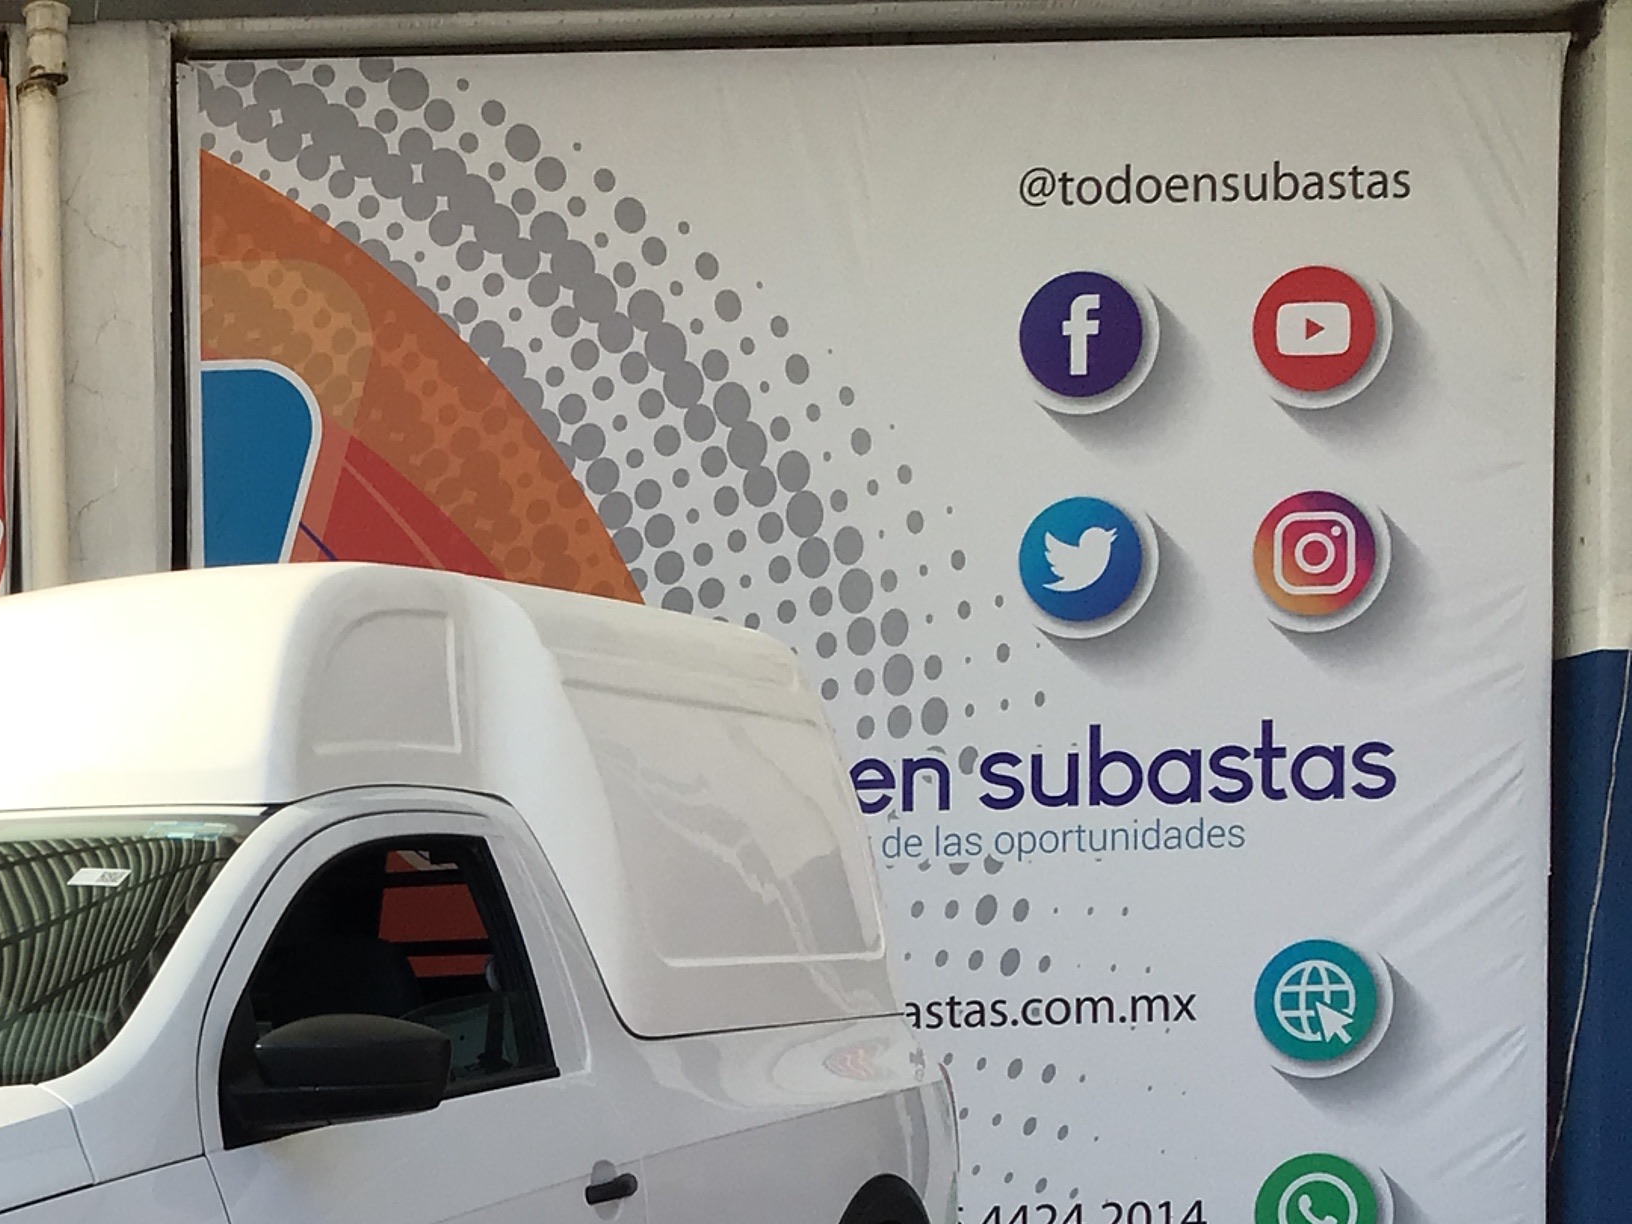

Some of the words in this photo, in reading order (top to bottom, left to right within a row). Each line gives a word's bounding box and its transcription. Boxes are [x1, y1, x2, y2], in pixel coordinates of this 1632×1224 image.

[1018, 160, 1412, 207] @todoensubastas
[849, 757, 951, 815] en
[978, 718, 1398, 810] subastas
[881, 825, 924, 859] de
[934, 824, 984, 857] las
[994, 816, 1247, 863] oportunidades
